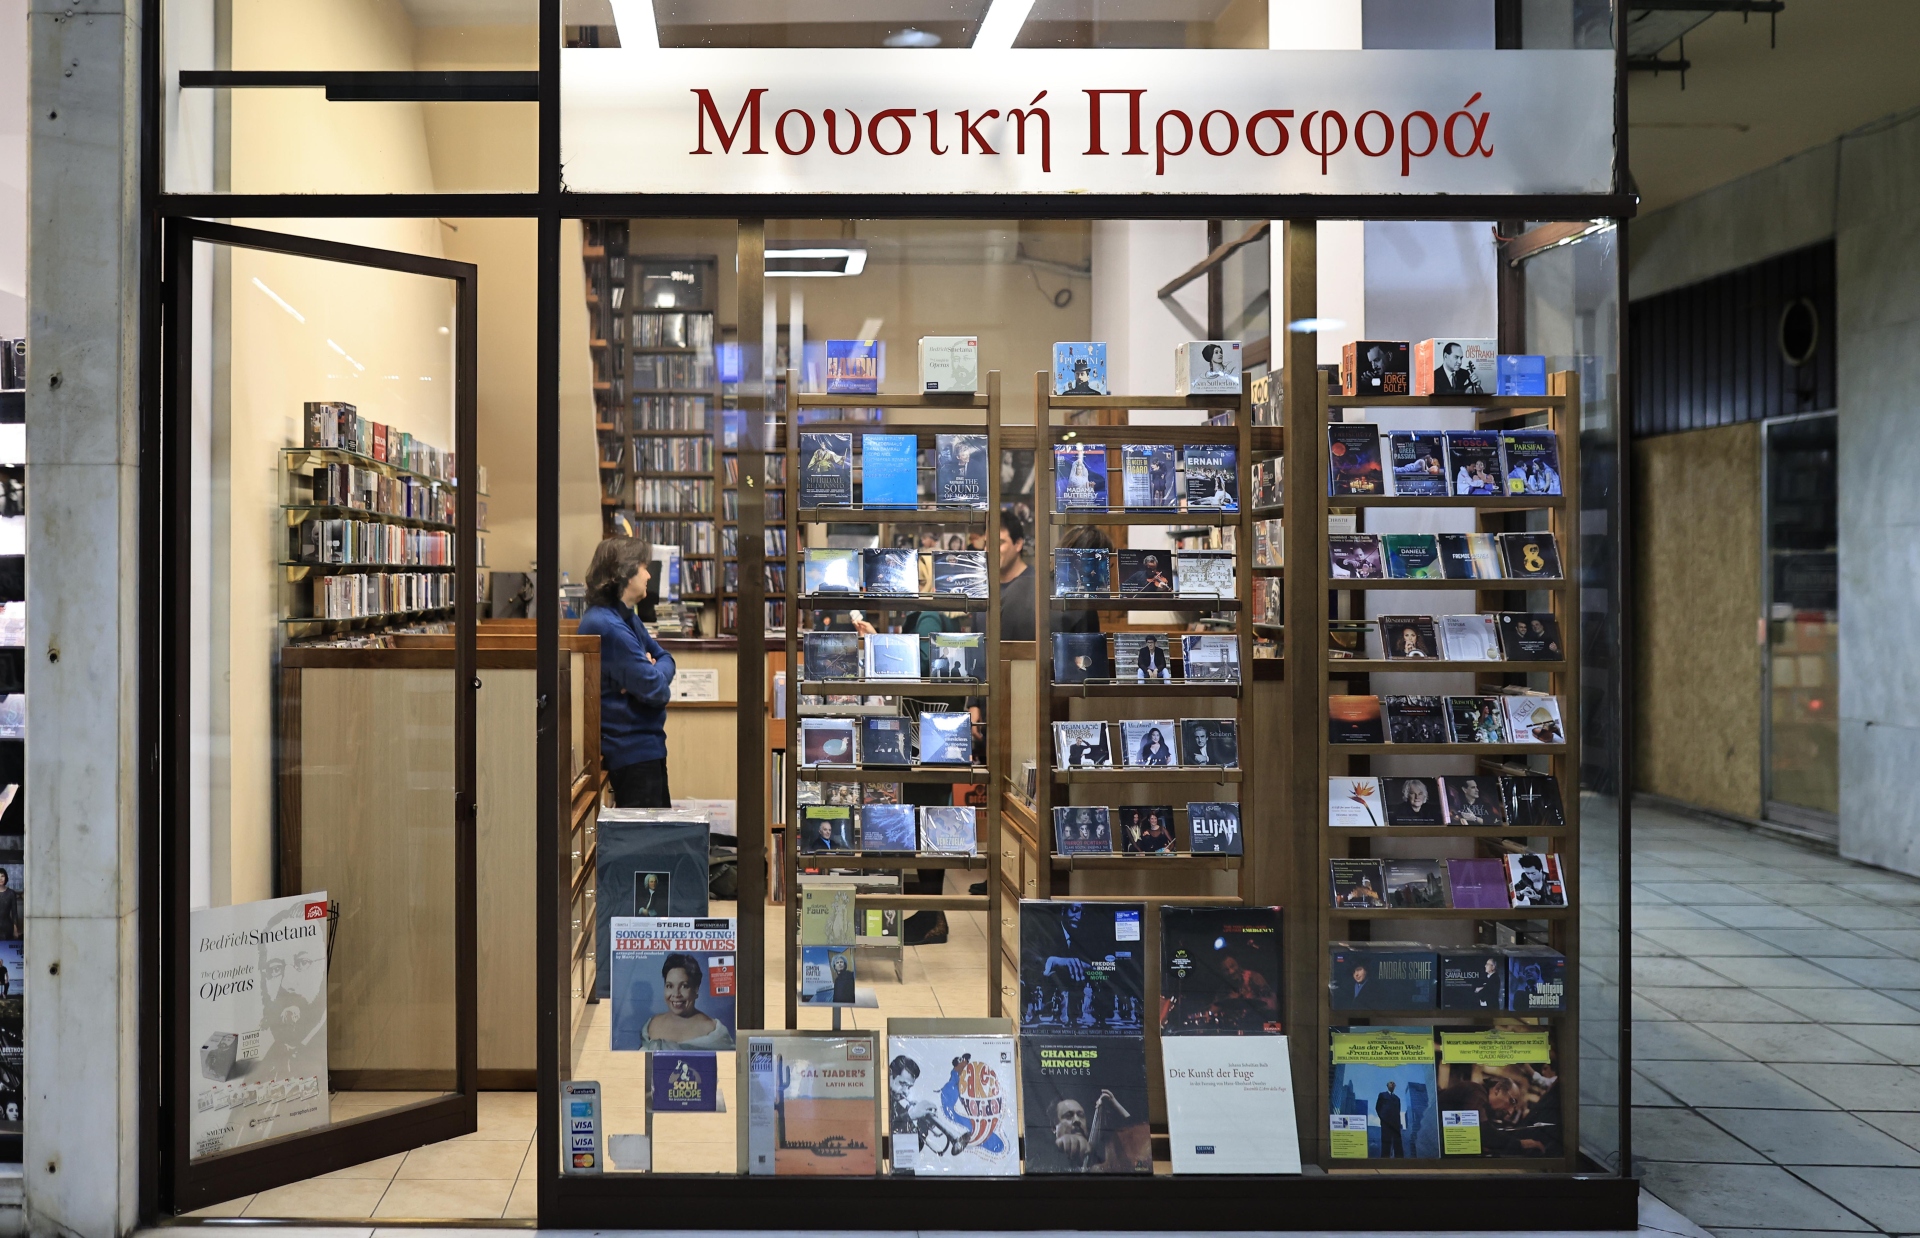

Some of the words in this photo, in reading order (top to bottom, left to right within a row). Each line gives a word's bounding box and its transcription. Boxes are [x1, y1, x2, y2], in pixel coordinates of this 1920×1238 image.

[689, 88, 1051, 172] Μουσική
[1082, 90, 1493, 176] Προσφορά
[1064, 356, 1098, 365] PUCCINI
[1383, 374, 1407, 384] JORGE
[1383, 384, 1407, 393] BOLET
[1458, 439, 1488, 447] TOSCA
[1513, 443, 1545, 451] PARSIFAL
[1187, 457, 1223, 466] ERNANI
[1126, 466, 1148, 474] FIGARO
[944, 484, 979, 493] SOUND
[868, 782, 893, 790] SADKO
[1193, 819, 1237, 838] ELIJAH
[806, 907, 829, 915] Fauré
[615, 930, 653, 939] SONGS
[653, 930, 660, 939] I
[660, 930, 687, 939] LIKE
[687, 930, 704, 939] TO
[704, 930, 735, 940] SING!
[615, 939, 672, 951] HELEN
[674, 939, 736, 951] HUMES
[211, 964, 254, 981] Complete
[1378, 958, 1407, 980] ANDRÁS
[1408, 961, 1432, 980] SCHIFF
[1444, 971, 1479, 979] SAWALLISCH
[199, 978, 254, 1001] Operas
[1536, 982, 1564, 996] Wolfgang
[1528, 993, 1560, 1005] Sawallisch
[1040, 1050, 1098, 1059] CHARLES
[1041, 1059, 1091, 1068] MINGUS
[800, 1069, 819, 1078] CAL
[822, 1069, 866, 1078] TJADER'S
[1040, 1068, 1091, 1076] CHANGES
[1169, 1068, 1186, 1078] Die
[1187, 1068, 1214, 1078] Kunst
[1216, 1068, 1231, 1078] der
[1232, 1068, 1255, 1081] Fuge
[673, 1081, 698, 1090] SOLTI
[668, 1089, 702, 1098] EUROPE
[574, 1121, 593, 1129] VISA
[574, 1138, 593, 1146] VISA
